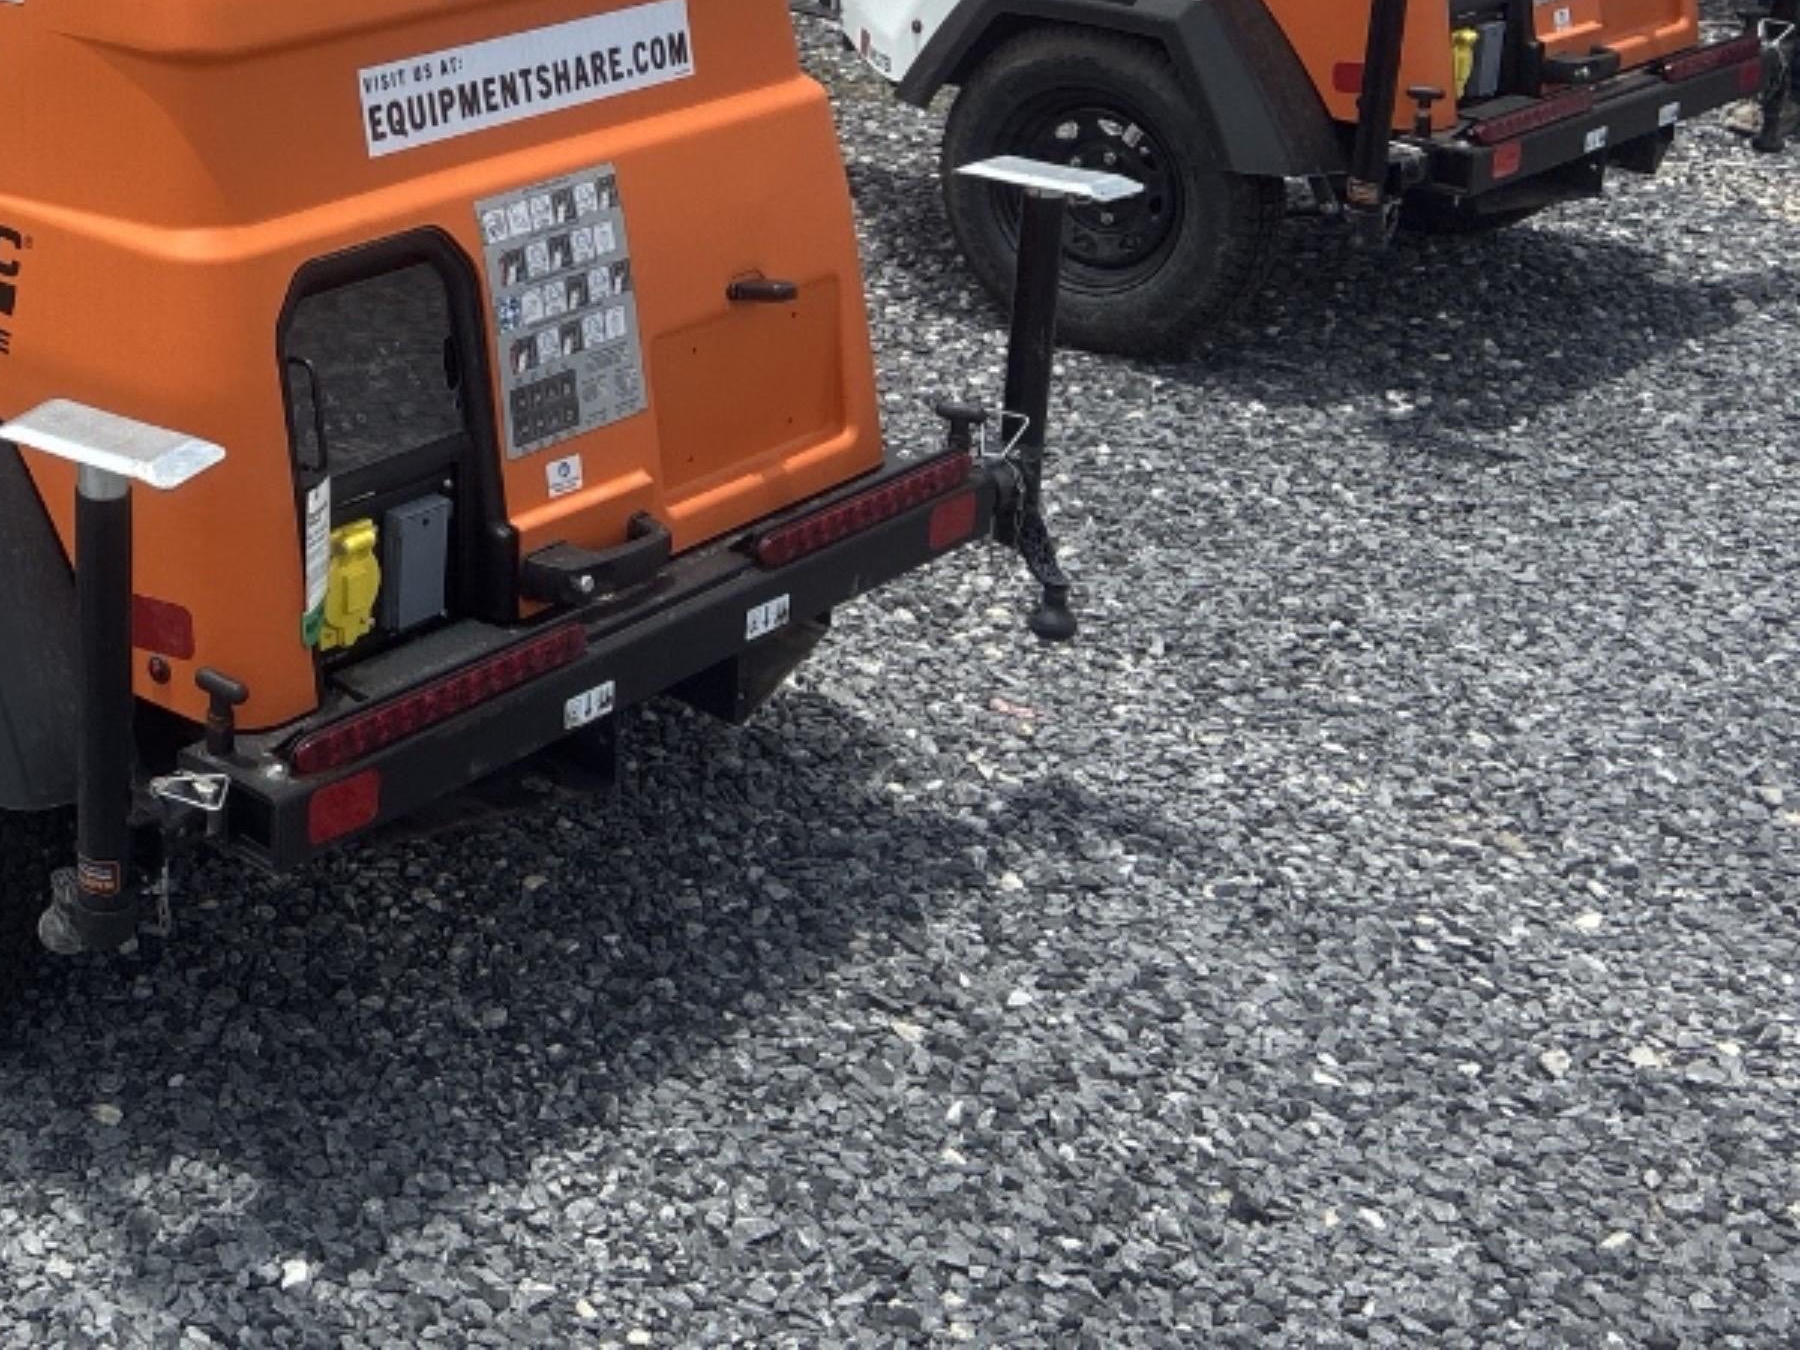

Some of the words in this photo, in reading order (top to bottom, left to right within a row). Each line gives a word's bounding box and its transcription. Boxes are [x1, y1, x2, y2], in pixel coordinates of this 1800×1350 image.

[362, 68, 406, 93] VISIT
[413, 63, 432, 83] US
[440, 56, 463, 76] AT:
[368, 30, 689, 142] EQUIPMENTSHARE.COM
